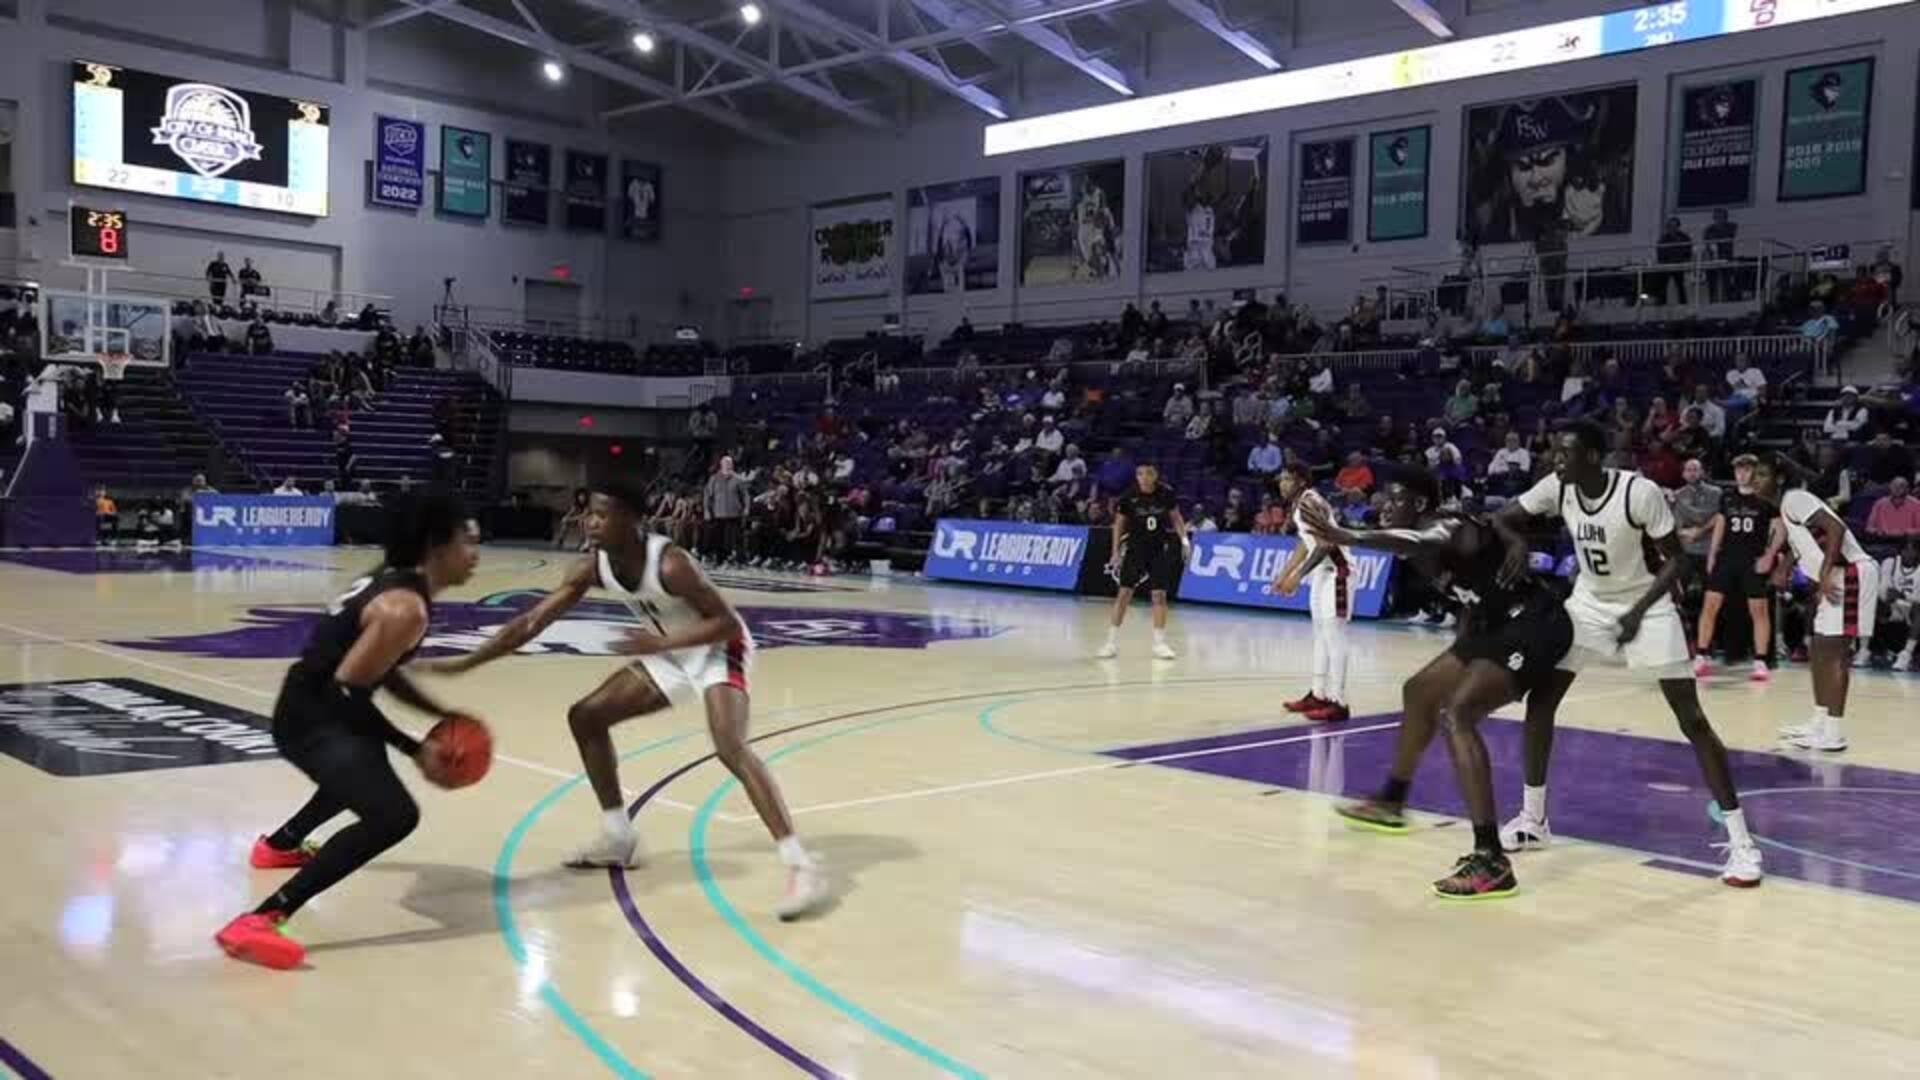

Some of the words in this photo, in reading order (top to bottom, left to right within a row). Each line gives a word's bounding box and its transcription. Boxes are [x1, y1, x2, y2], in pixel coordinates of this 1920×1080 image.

[1633, 2, 1687, 32] 2:35
[108, 169, 129, 184] 22
[382, 184, 417, 201] 2022
[87, 211, 123, 229] 2:35
[100, 228, 117, 253] 8
[242, 506, 332, 528] LEAGUEREADY
[1146, 515, 1158, 532] 0
[1730, 517, 1754, 533] 30
[1577, 523, 1607, 544] LUHI
[979, 530, 1082, 567] LEAGUEREADY
[1583, 547, 1611, 576] 12
